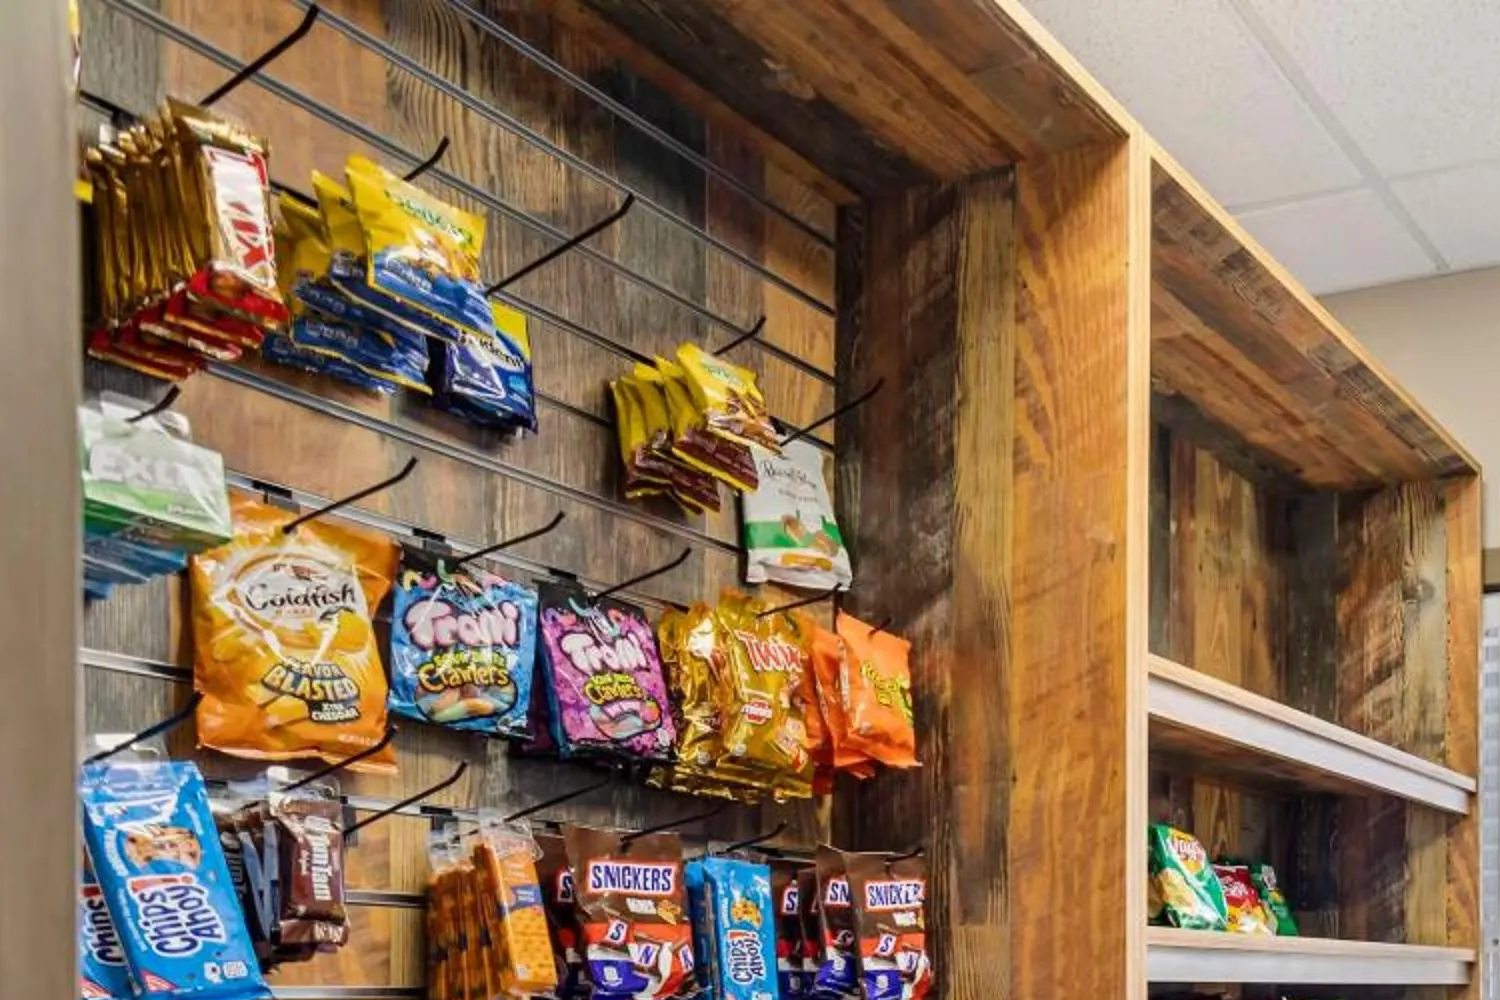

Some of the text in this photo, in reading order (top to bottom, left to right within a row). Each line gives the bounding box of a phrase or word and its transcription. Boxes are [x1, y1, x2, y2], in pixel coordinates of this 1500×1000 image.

[268, 665, 357, 701] BLASTED
[592, 864, 673, 892] SNICKERS
[139, 889, 200, 955] Chips
